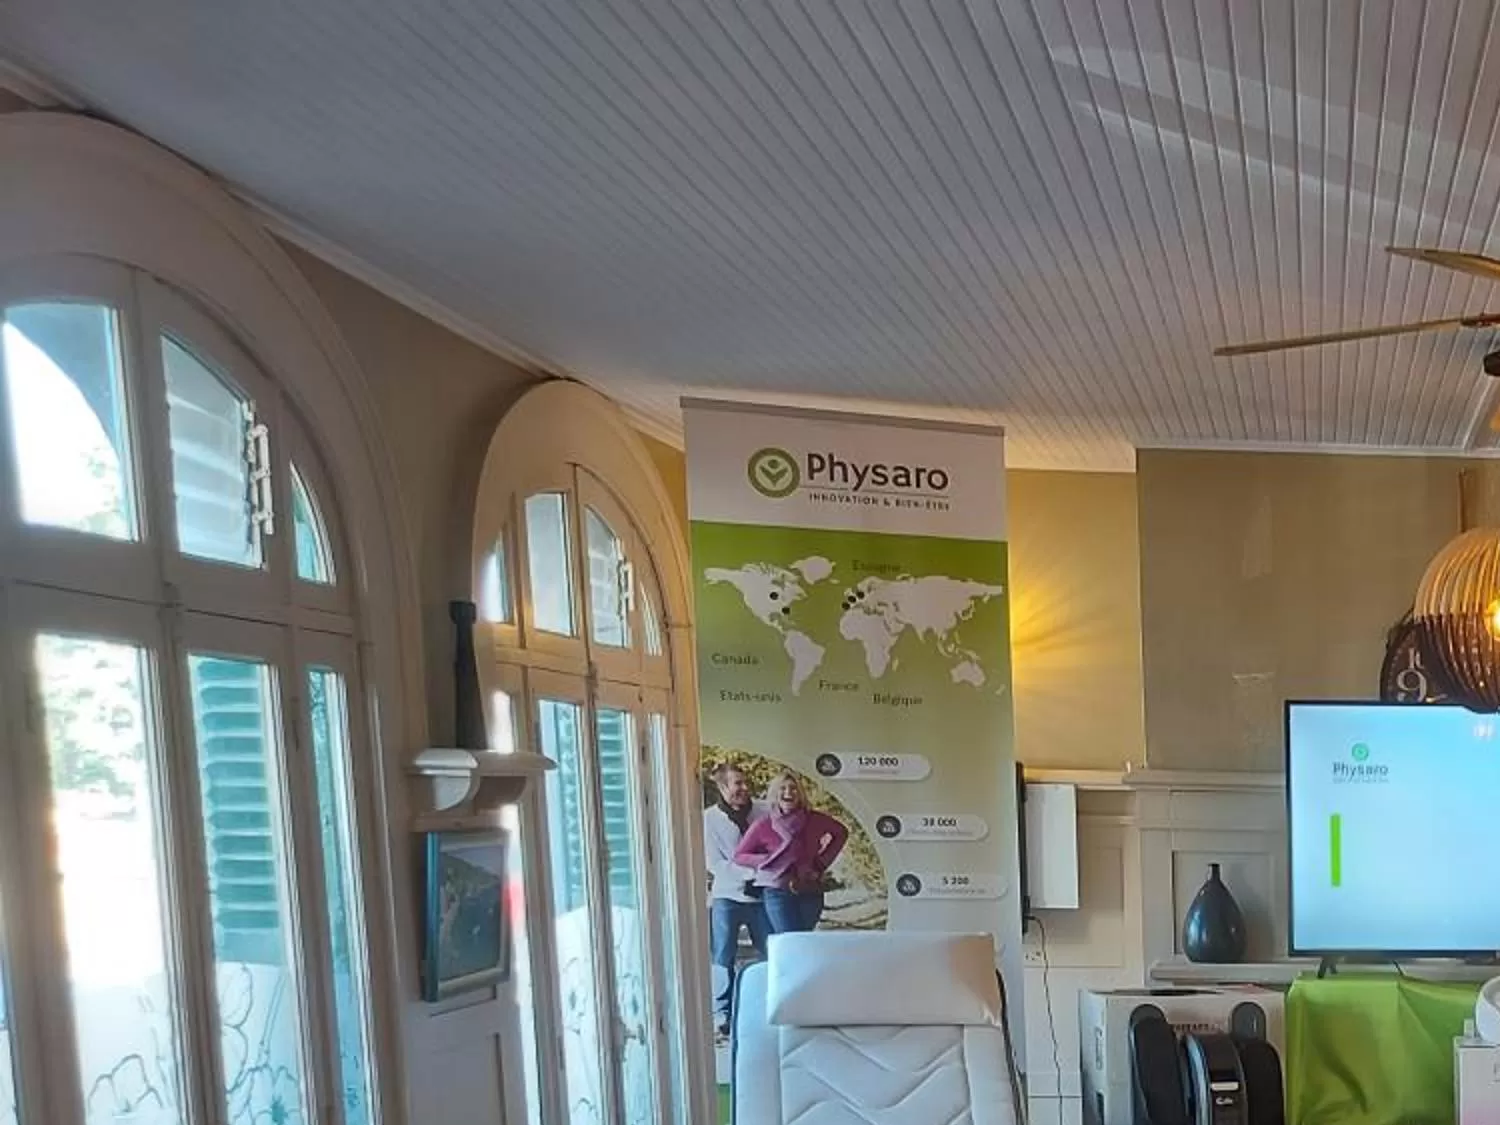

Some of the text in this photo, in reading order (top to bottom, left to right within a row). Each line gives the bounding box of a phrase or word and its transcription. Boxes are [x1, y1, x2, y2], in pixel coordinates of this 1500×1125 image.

[807, 452, 949, 492] Physaro
[809, 493, 879, 505] INNOVATION
[711, 653, 760, 665] Canada
[819, 680, 859, 691] France
[872, 694, 923, 708] Belgique
[1332, 761, 1389, 780] Physaro
